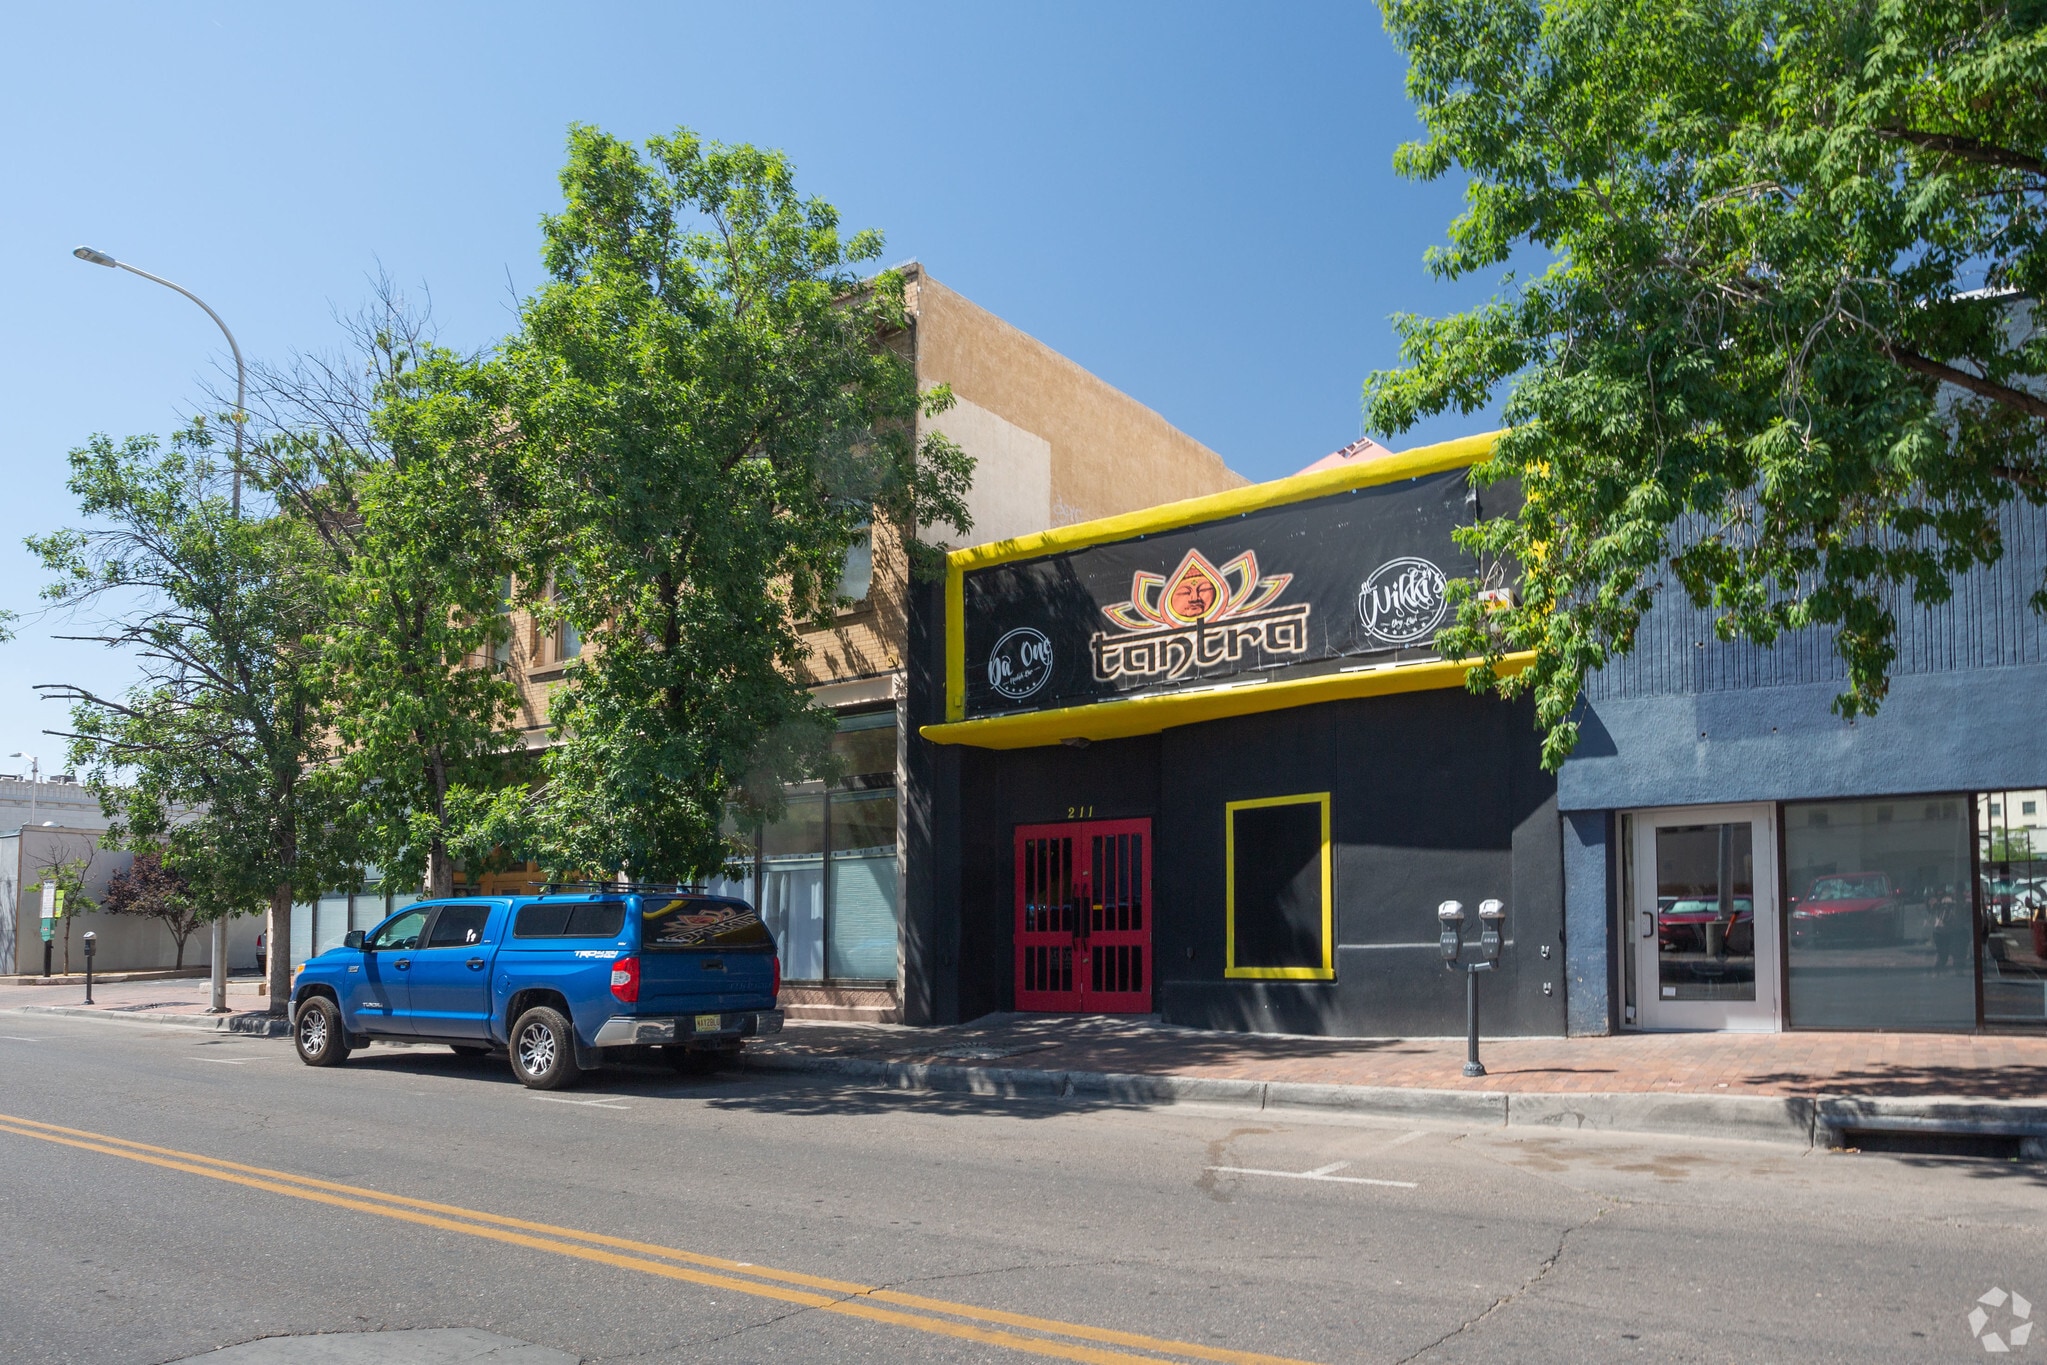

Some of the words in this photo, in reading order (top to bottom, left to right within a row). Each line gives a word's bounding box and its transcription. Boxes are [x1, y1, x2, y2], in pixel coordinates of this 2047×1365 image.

[1360, 563, 1446, 636] Nikki's
[1091, 604, 1309, 682] tantra
[1067, 805, 1093, 819] 211
